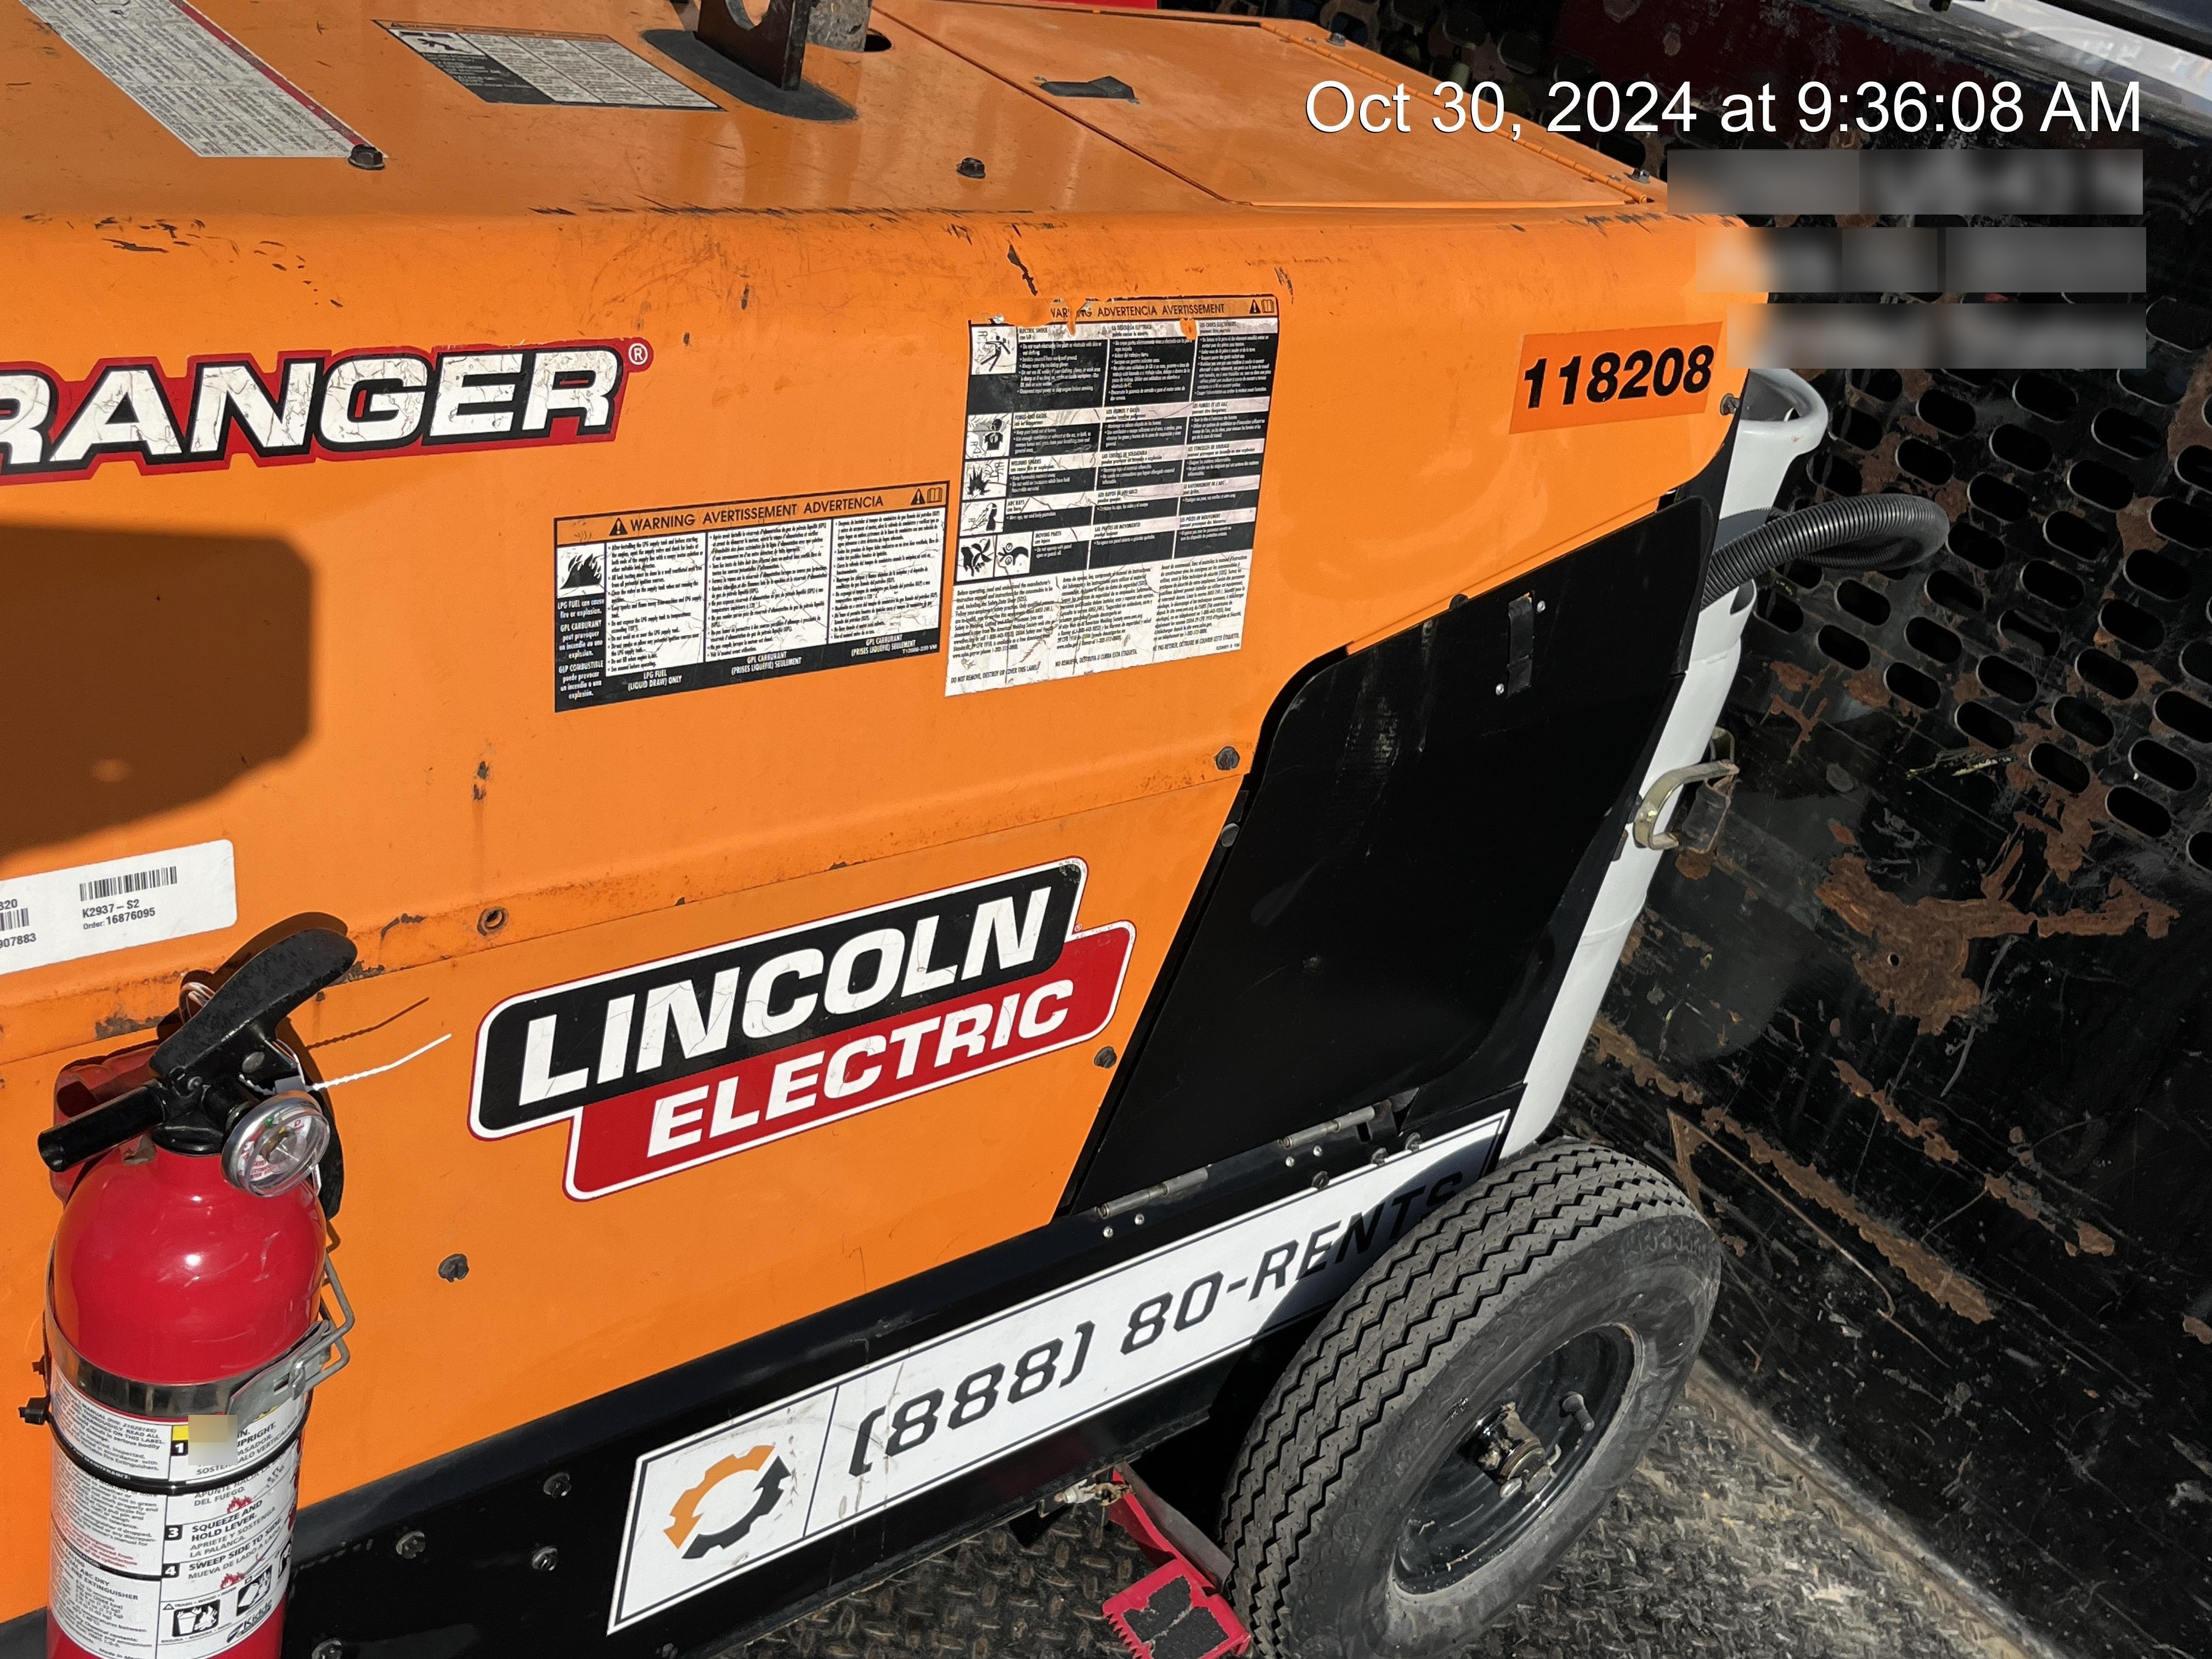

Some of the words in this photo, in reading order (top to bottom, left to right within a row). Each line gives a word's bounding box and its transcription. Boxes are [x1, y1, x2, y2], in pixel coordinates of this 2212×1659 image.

[1098, 306, 1157, 317] ADVERTENCIA
[1162, 304, 1224, 315] AVERTISSEMENT
[1524, 345, 1714, 409] 118208
[0, 350, 617, 466] RANGER
[630, 514, 696, 532] WARNING
[702, 503, 798, 525] AVERTISSEMENT
[804, 495, 884, 514] ADVERTENCIA
[557, 601, 568, 610] LPG
[568, 599, 580, 608] FUEL
[628, 681, 647, 691] (LIQUID
[668, 675, 682, 684] ONLY
[655, 669, 667, 678] FUEL
[83, 921, 105, 930] Order:
[106, 907, 156, 925] 16876095
[518, 887, 1052, 1105] LINCOLN
[647, 979, 1074, 1158] ELECTRIC
[849, 1320, 1095, 1477] (888)
[1119, 1170, 1464, 1356] 80-RENTS
[126, 1429, 144, 1437] READ
[174, 1442, 184, 1453] 1
[194, 1497, 211, 1506] DEL
[215, 1487, 245, 1502] FUEGO.
[168, 1527, 179, 1537] 3
[192, 1513, 240, 1533] SQUEEZE
[241, 1500, 263, 1517] AND
[190, 1537, 227, 1550] APRIETE
[238, 1506, 275, 1534] SOSTENGA
[191, 1529, 222, 1542] HOLD
[224, 1513, 257, 1529] LEVER.
[165, 1565, 177, 1576] 4
[189, 1554, 226, 1571] SWEEP
[229, 1543, 250, 1559] SIDE
[252, 1534, 264, 1545] TO
[204, 1536, 246, 1555] PALANCA.
[188, 1566, 221, 1579] MUEVA
[223, 1561, 234, 1570] DE
[236, 1549, 257, 1566] LADO
[80, 1569, 94, 1579] ABC
[95, 1576, 110, 1586] DRY
[84, 1578, 138, 1600] EXTINGUISHER
